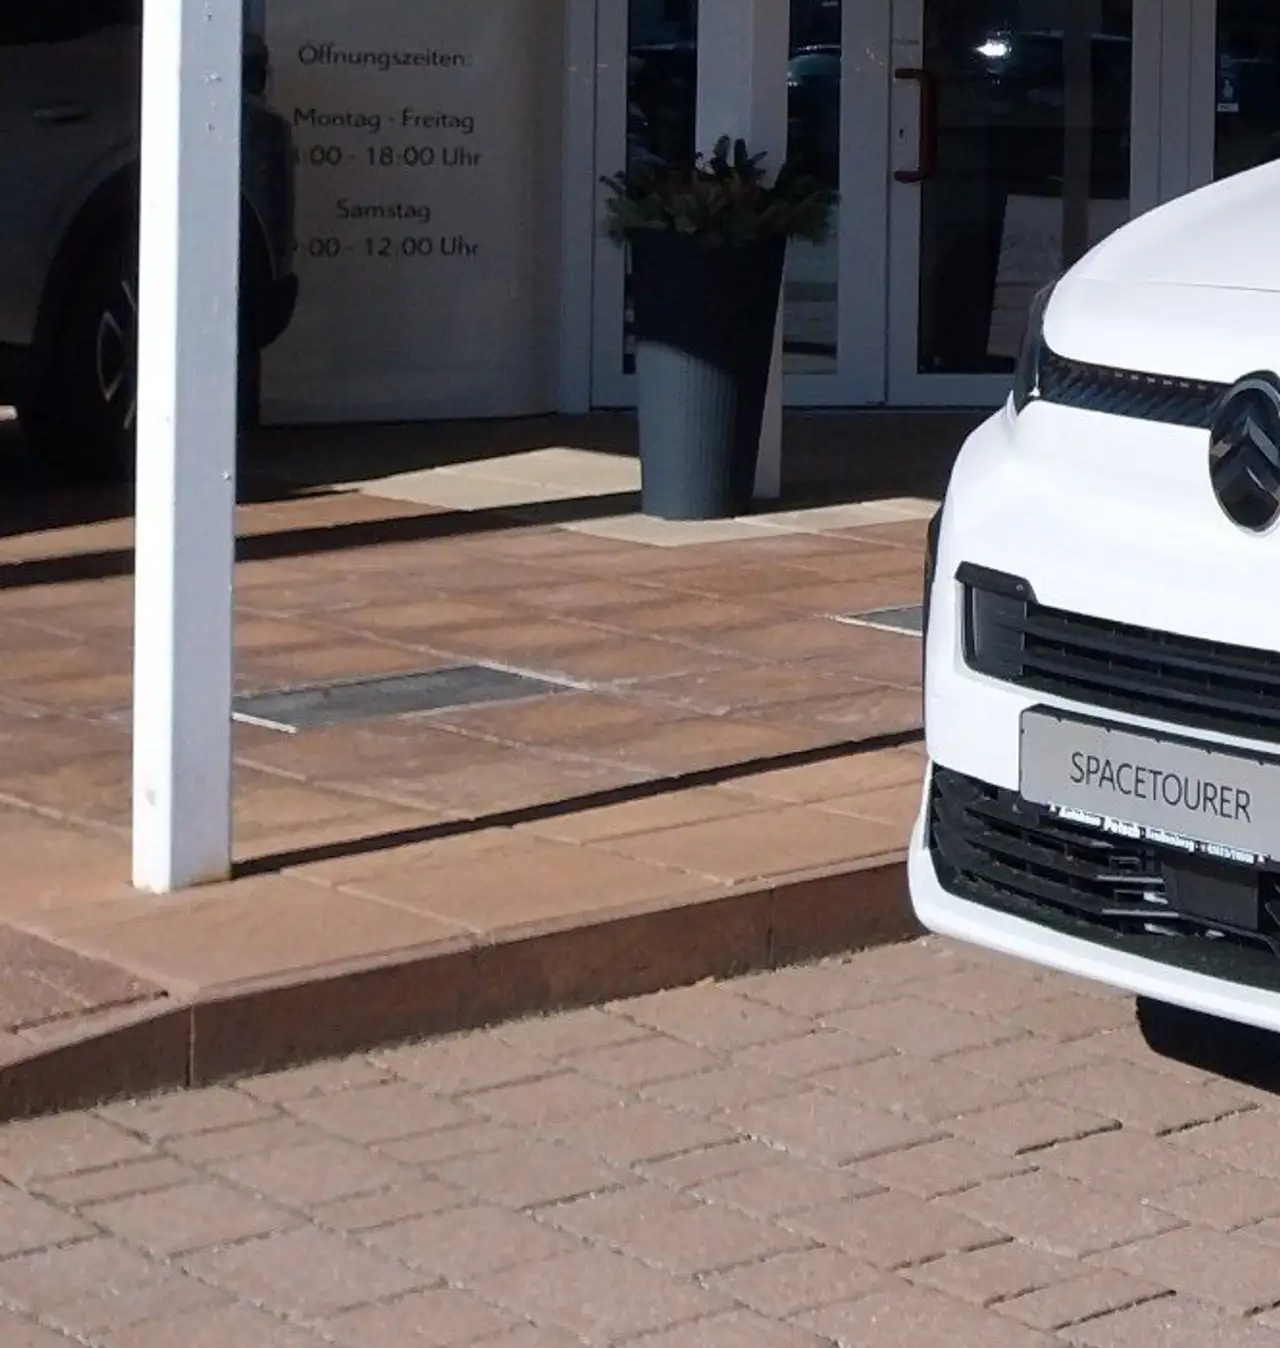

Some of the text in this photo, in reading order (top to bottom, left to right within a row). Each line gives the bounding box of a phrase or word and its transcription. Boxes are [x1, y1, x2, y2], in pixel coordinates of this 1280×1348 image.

[294, 107, 381, 134] Montag
[401, 109, 475, 135] Freitag
[367, 146, 435, 166] 18:00
[442, 147, 482, 166] Uhr
[335, 199, 431, 224] Samstag
[440, 235, 479, 257] Uhr
[1069, 751, 1252, 823] SPACETOURER
